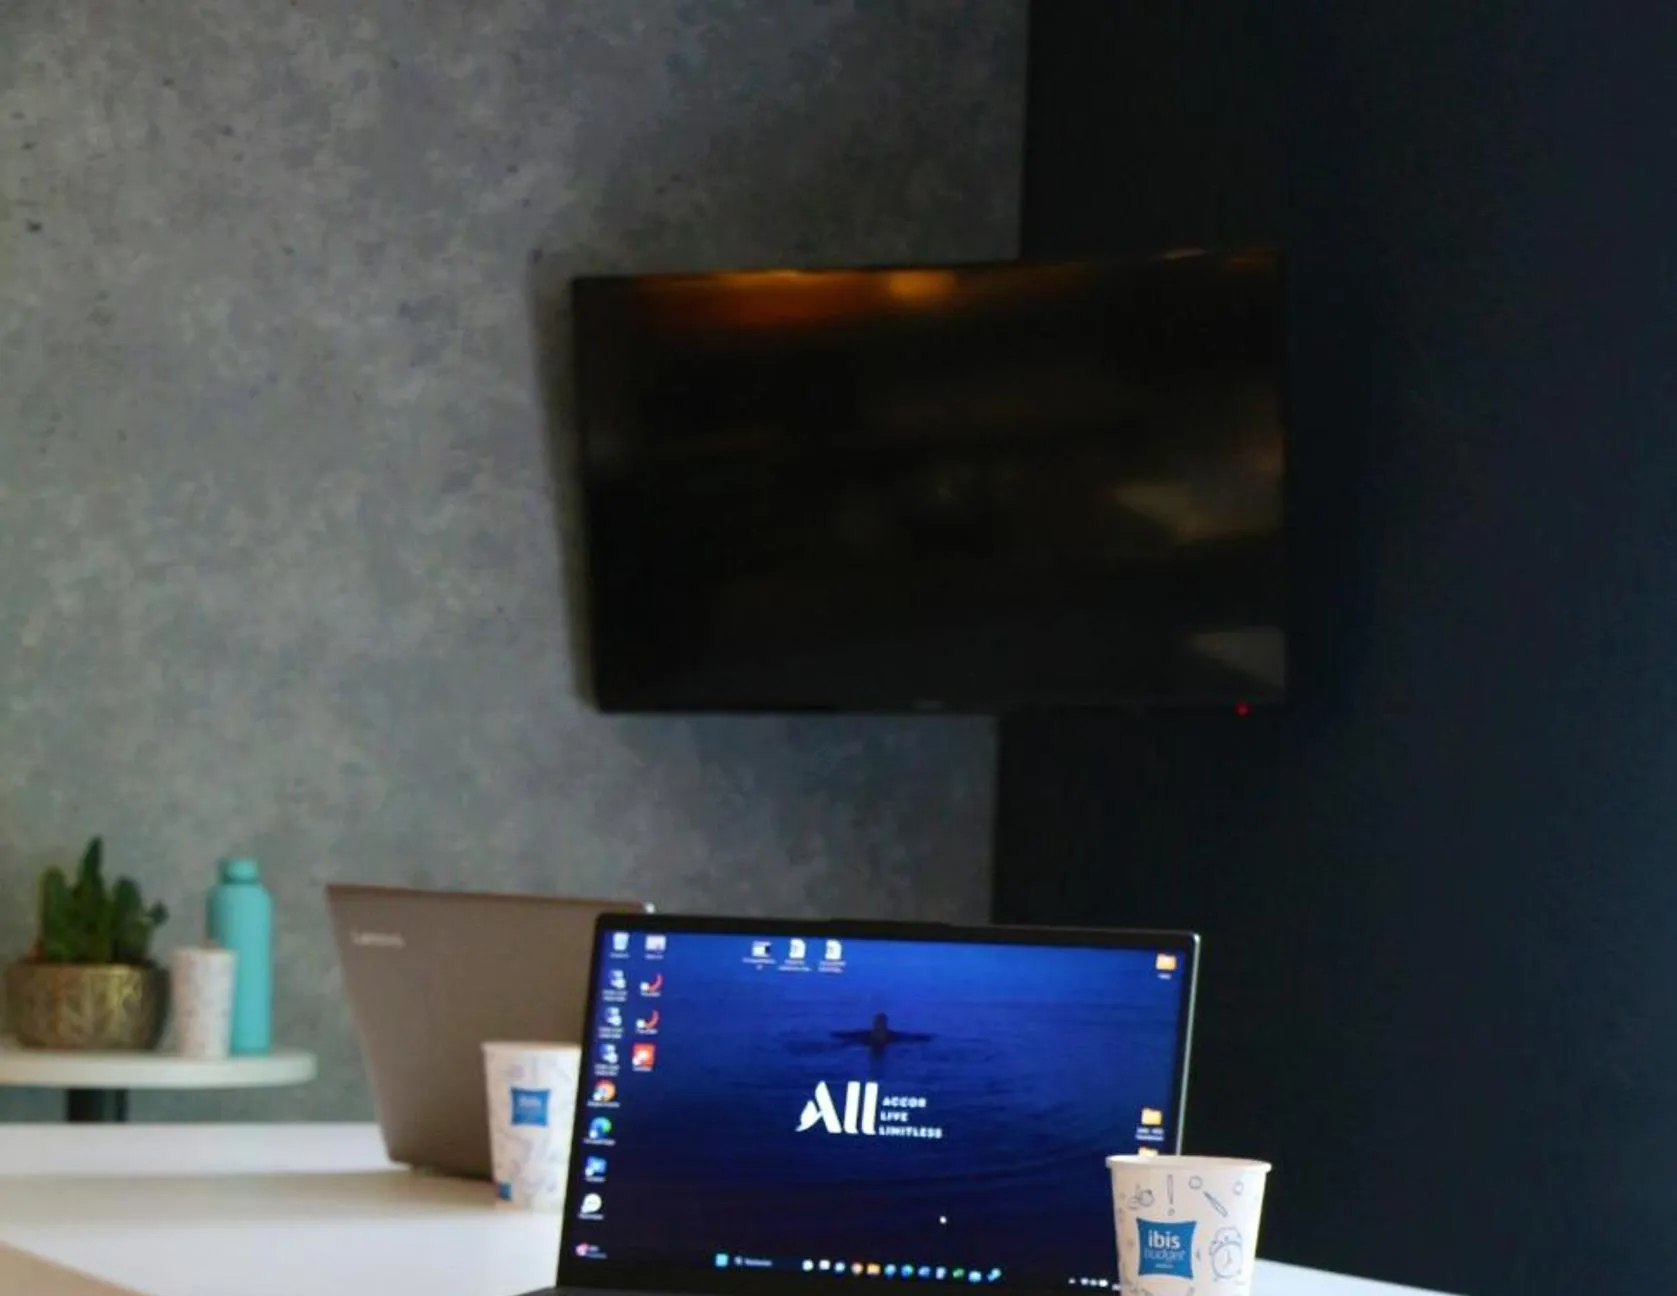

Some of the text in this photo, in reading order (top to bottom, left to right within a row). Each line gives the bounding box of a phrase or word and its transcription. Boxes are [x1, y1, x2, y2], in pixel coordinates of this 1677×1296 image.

[882, 1096, 927, 1108] ACCOR
[880, 1111, 908, 1122] LIVE
[879, 1125, 943, 1138] LIMITLESS
[1148, 1230, 1181, 1249] ibis
[1144, 1248, 1186, 1264] budget
